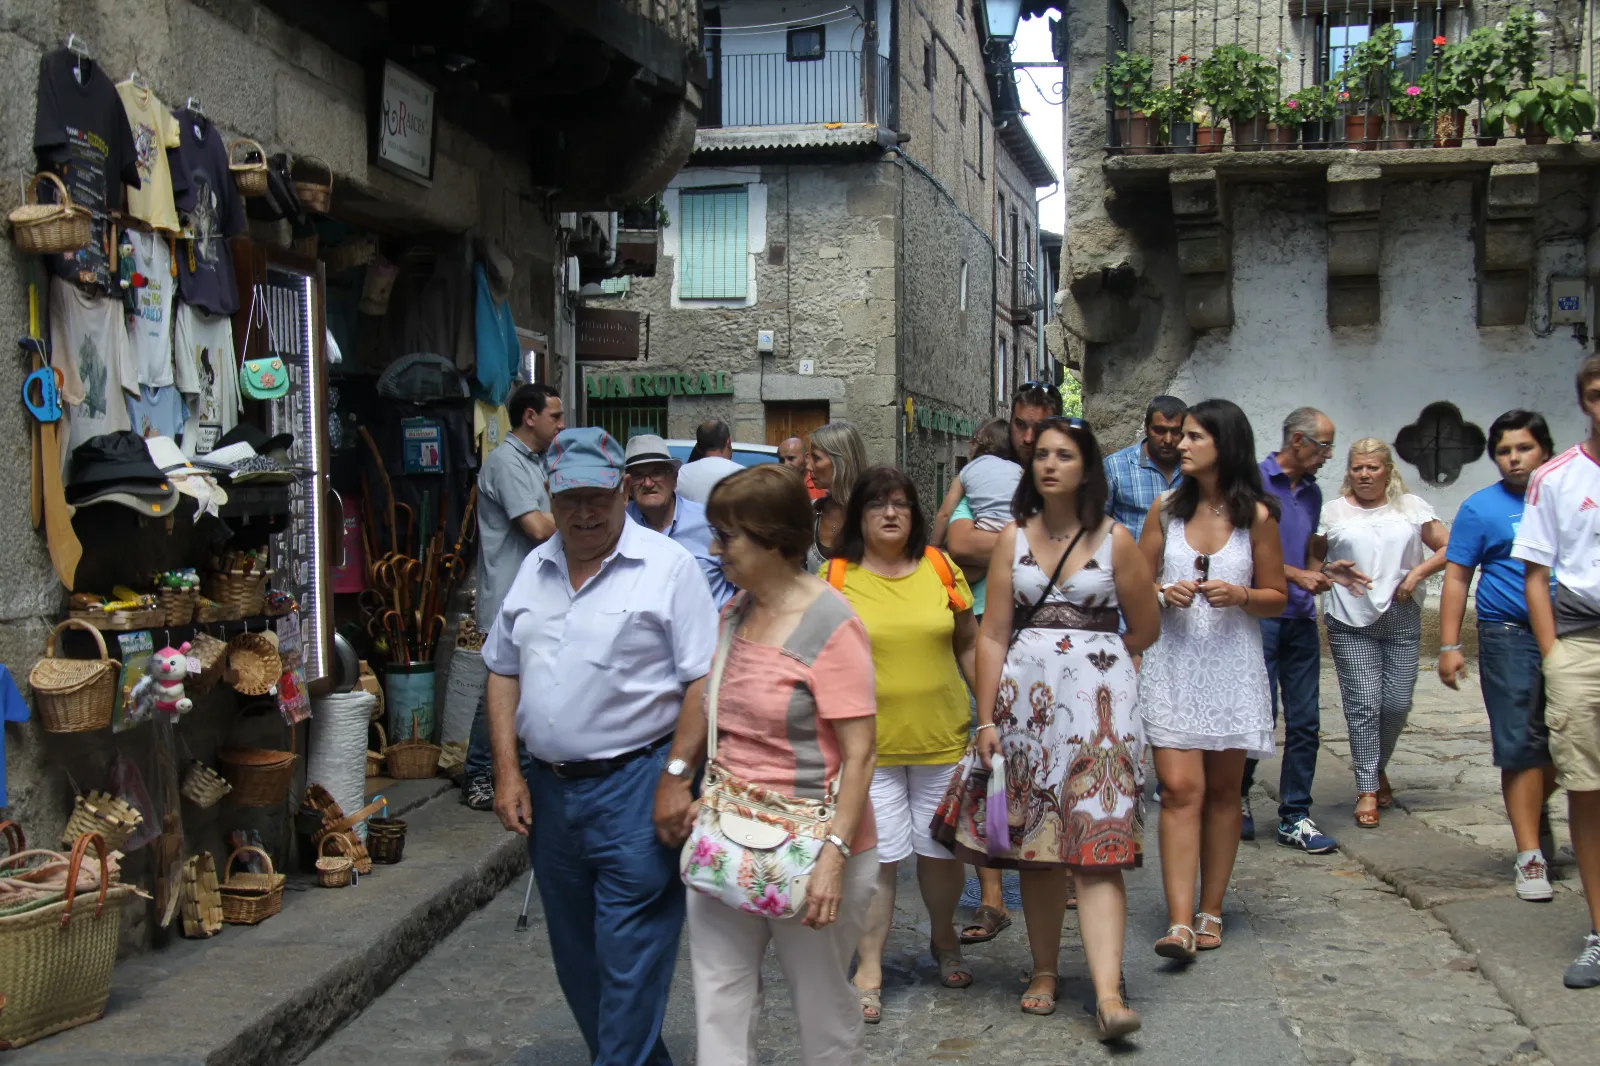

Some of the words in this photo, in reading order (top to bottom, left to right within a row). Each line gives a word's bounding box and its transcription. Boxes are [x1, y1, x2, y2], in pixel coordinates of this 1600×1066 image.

[803, 363, 810, 372] 2
[587, 375, 630, 399] AJA
[632, 370, 733, 397] RURAL
